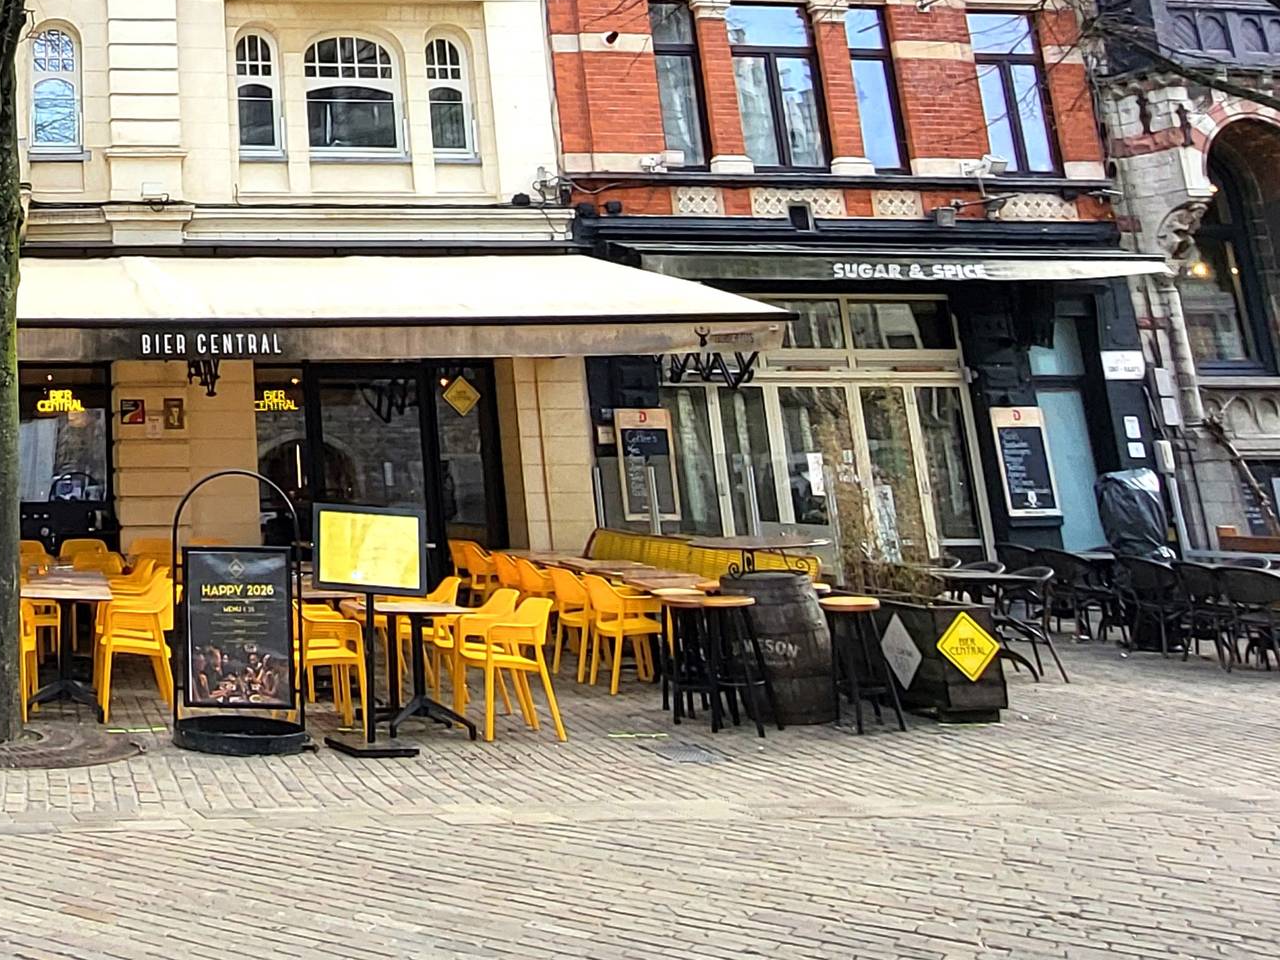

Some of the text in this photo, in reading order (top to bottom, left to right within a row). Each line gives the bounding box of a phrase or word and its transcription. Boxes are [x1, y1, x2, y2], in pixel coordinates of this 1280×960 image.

[833, 262, 986, 279] SUGAR & SPICE
[141, 333, 282, 354] BIER CENTRAL
[49, 390, 72, 402] BIER
[263, 390, 286, 402] BIER
[36, 401, 86, 413] CENTRAL
[254, 401, 299, 412] CENTRAL
[201, 584, 274, 596] HAPPY 2026
[958, 637, 977, 646] BIER
[949, 644, 987, 656] CENTRAL
